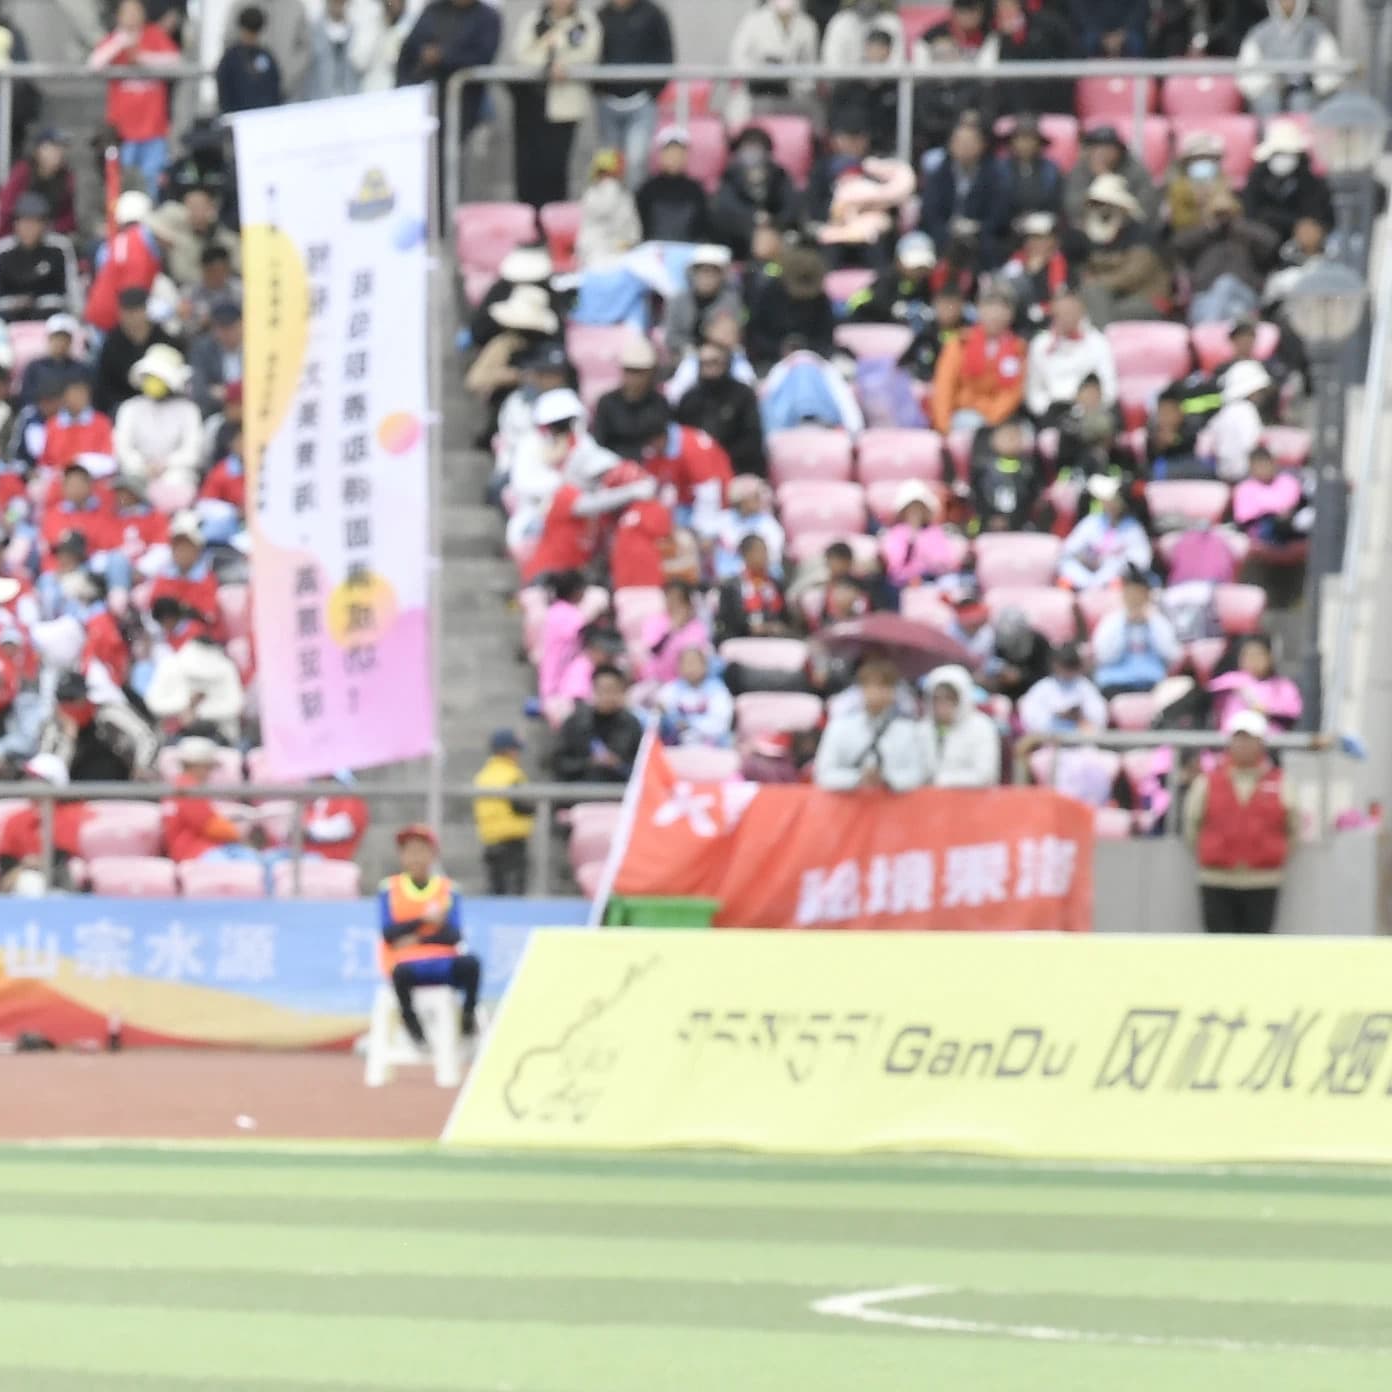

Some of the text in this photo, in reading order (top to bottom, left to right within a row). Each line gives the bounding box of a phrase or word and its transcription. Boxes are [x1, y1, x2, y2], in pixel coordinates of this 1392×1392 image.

[3, 919, 278, 982] 山宗水源
[883, 1026, 1077, 1080] GanDu
[1093, 1007, 1392, 1097] 冈杜水烟
